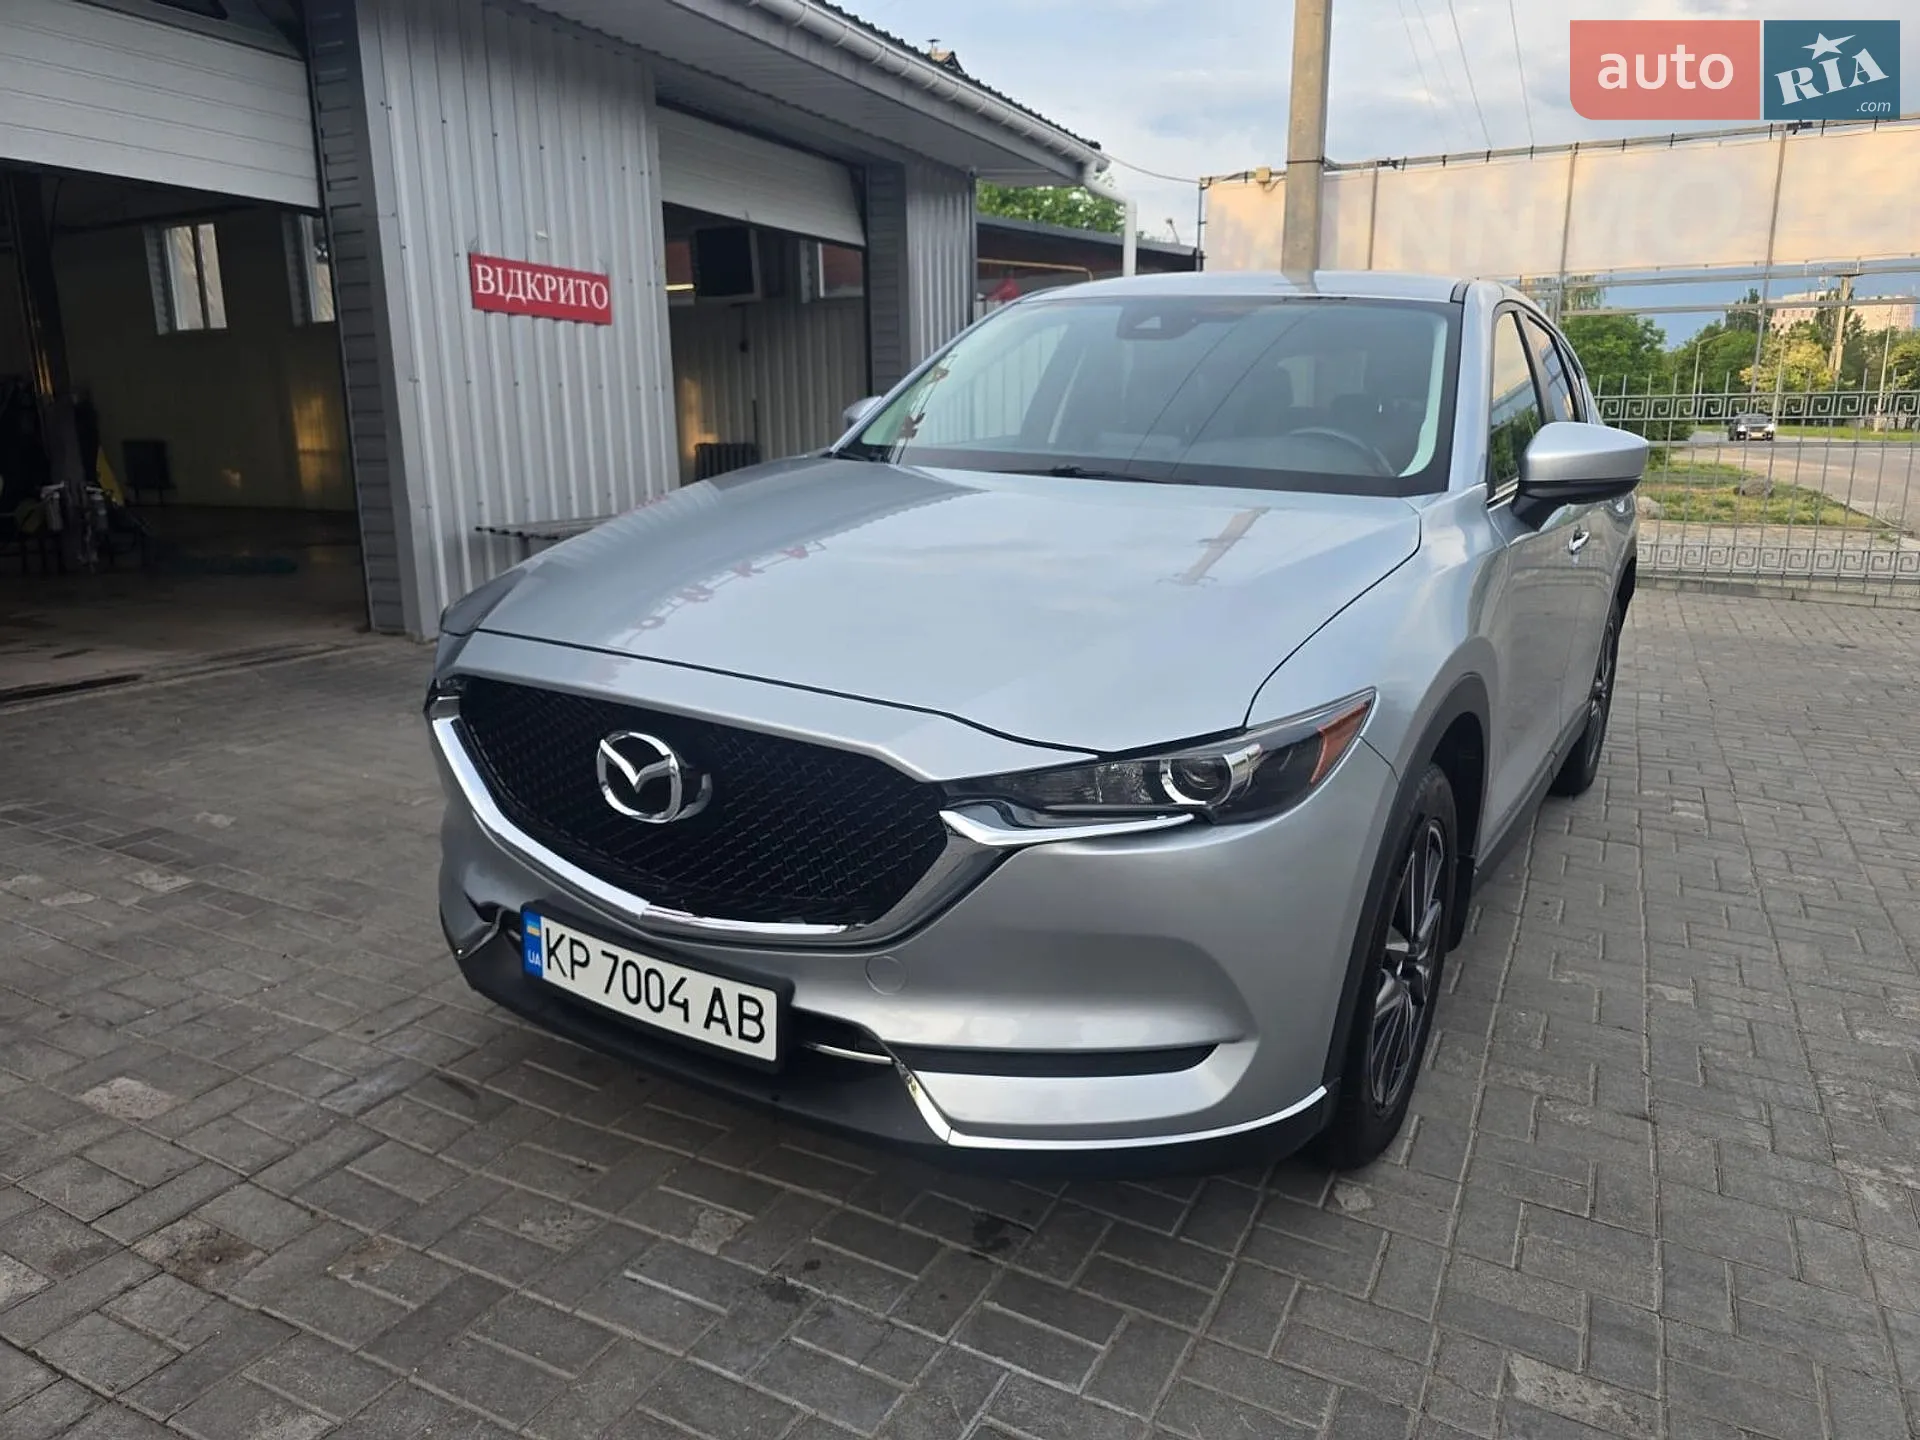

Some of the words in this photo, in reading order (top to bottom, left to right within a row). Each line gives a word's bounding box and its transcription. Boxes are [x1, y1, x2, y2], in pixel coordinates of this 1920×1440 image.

[475, 263, 609, 310] ВІДКРИТО
[527, 950, 542, 967] UA
[545, 927, 591, 981] KP
[600, 949, 690, 1024] 7004
[703, 986, 766, 1044] AB
